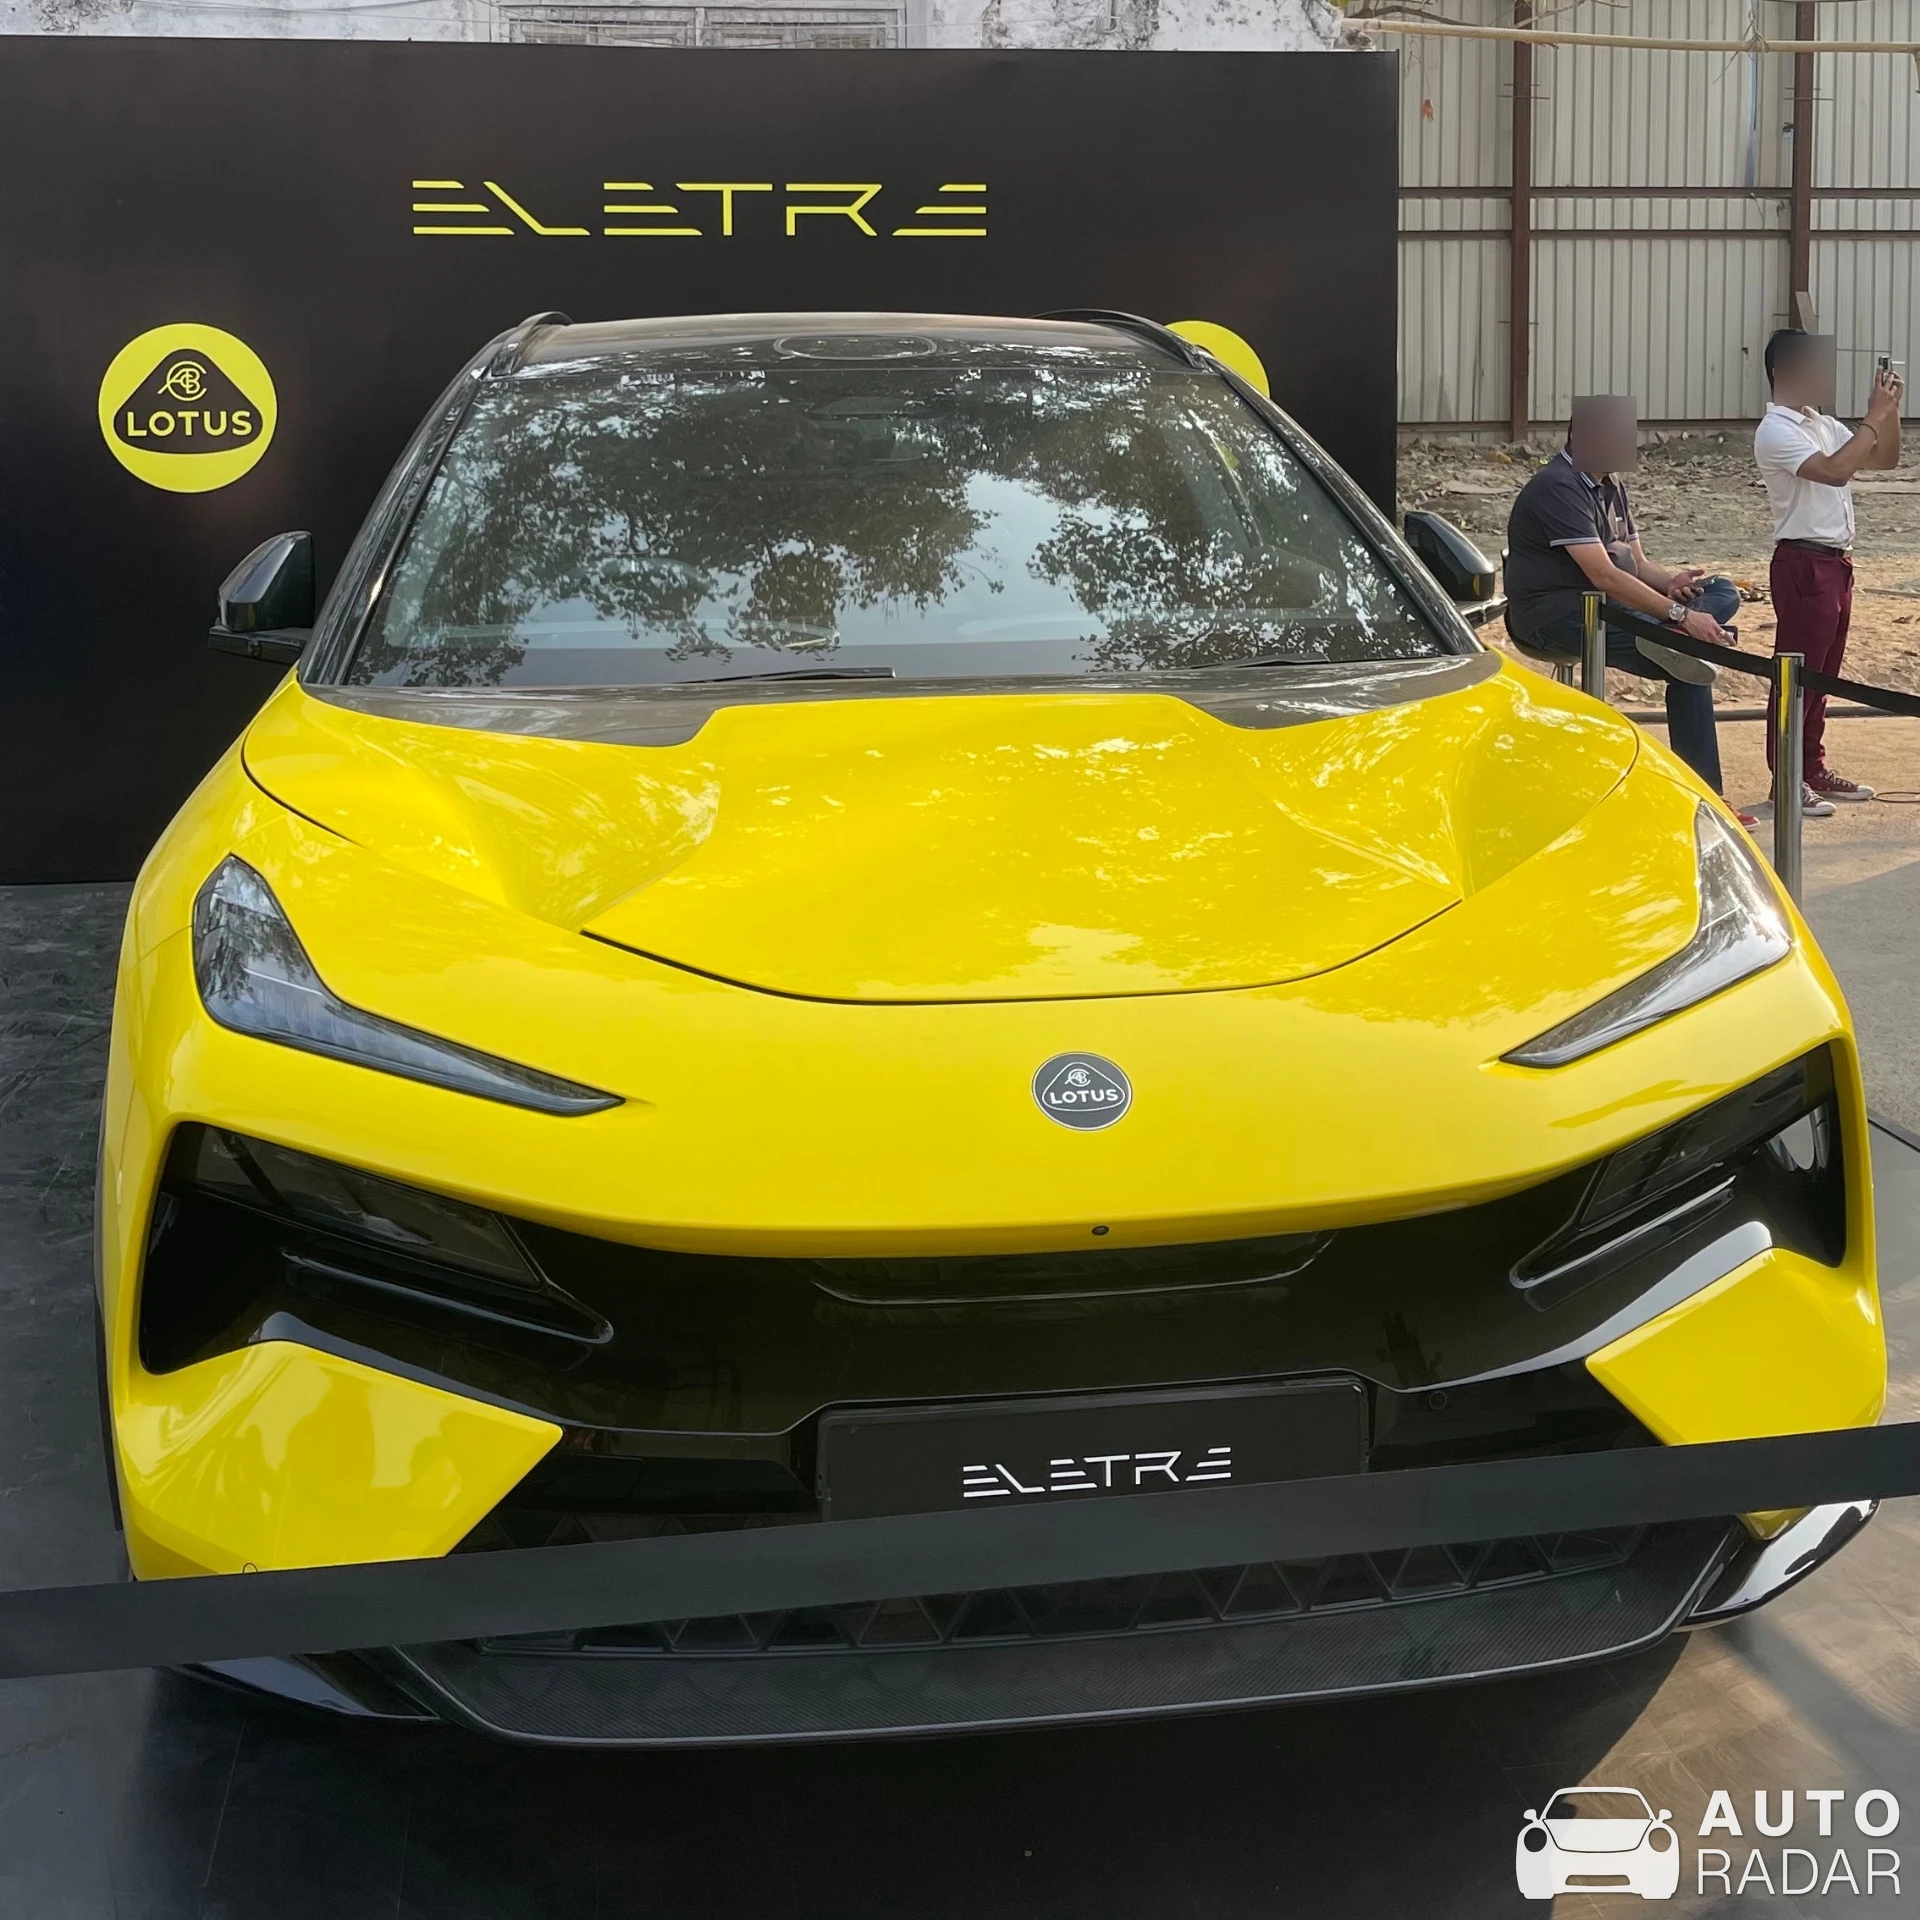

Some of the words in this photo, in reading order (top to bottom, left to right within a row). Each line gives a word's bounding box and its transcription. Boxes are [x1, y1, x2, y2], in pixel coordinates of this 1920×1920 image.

[412, 180, 987, 237] ELETRE
[126, 411, 253, 437] LOTUS
[1049, 1088, 1119, 1105] LOTUS
[962, 1446, 1232, 1498] ELETRE
